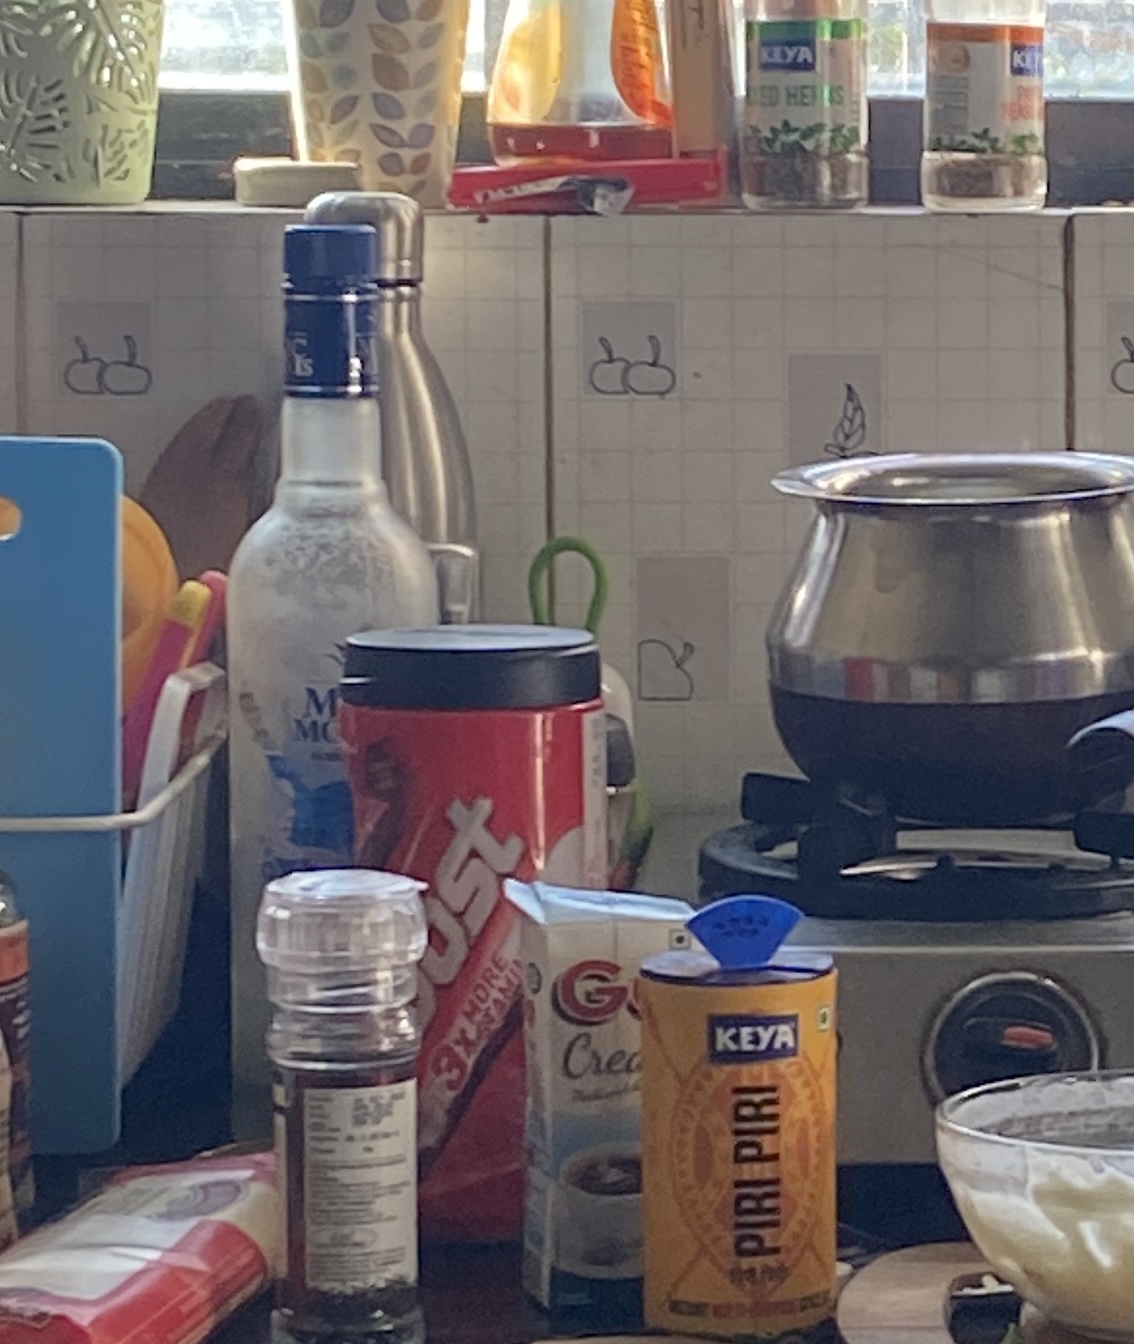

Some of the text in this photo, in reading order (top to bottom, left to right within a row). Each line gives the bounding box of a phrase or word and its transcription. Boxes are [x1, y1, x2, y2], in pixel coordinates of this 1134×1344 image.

[760, 45, 813, 64] KEYA
[714, 1020, 798, 1055] KEYA
[731, 1085, 781, 1174] PIRI
[733, 1178, 782, 1259] PIRI
